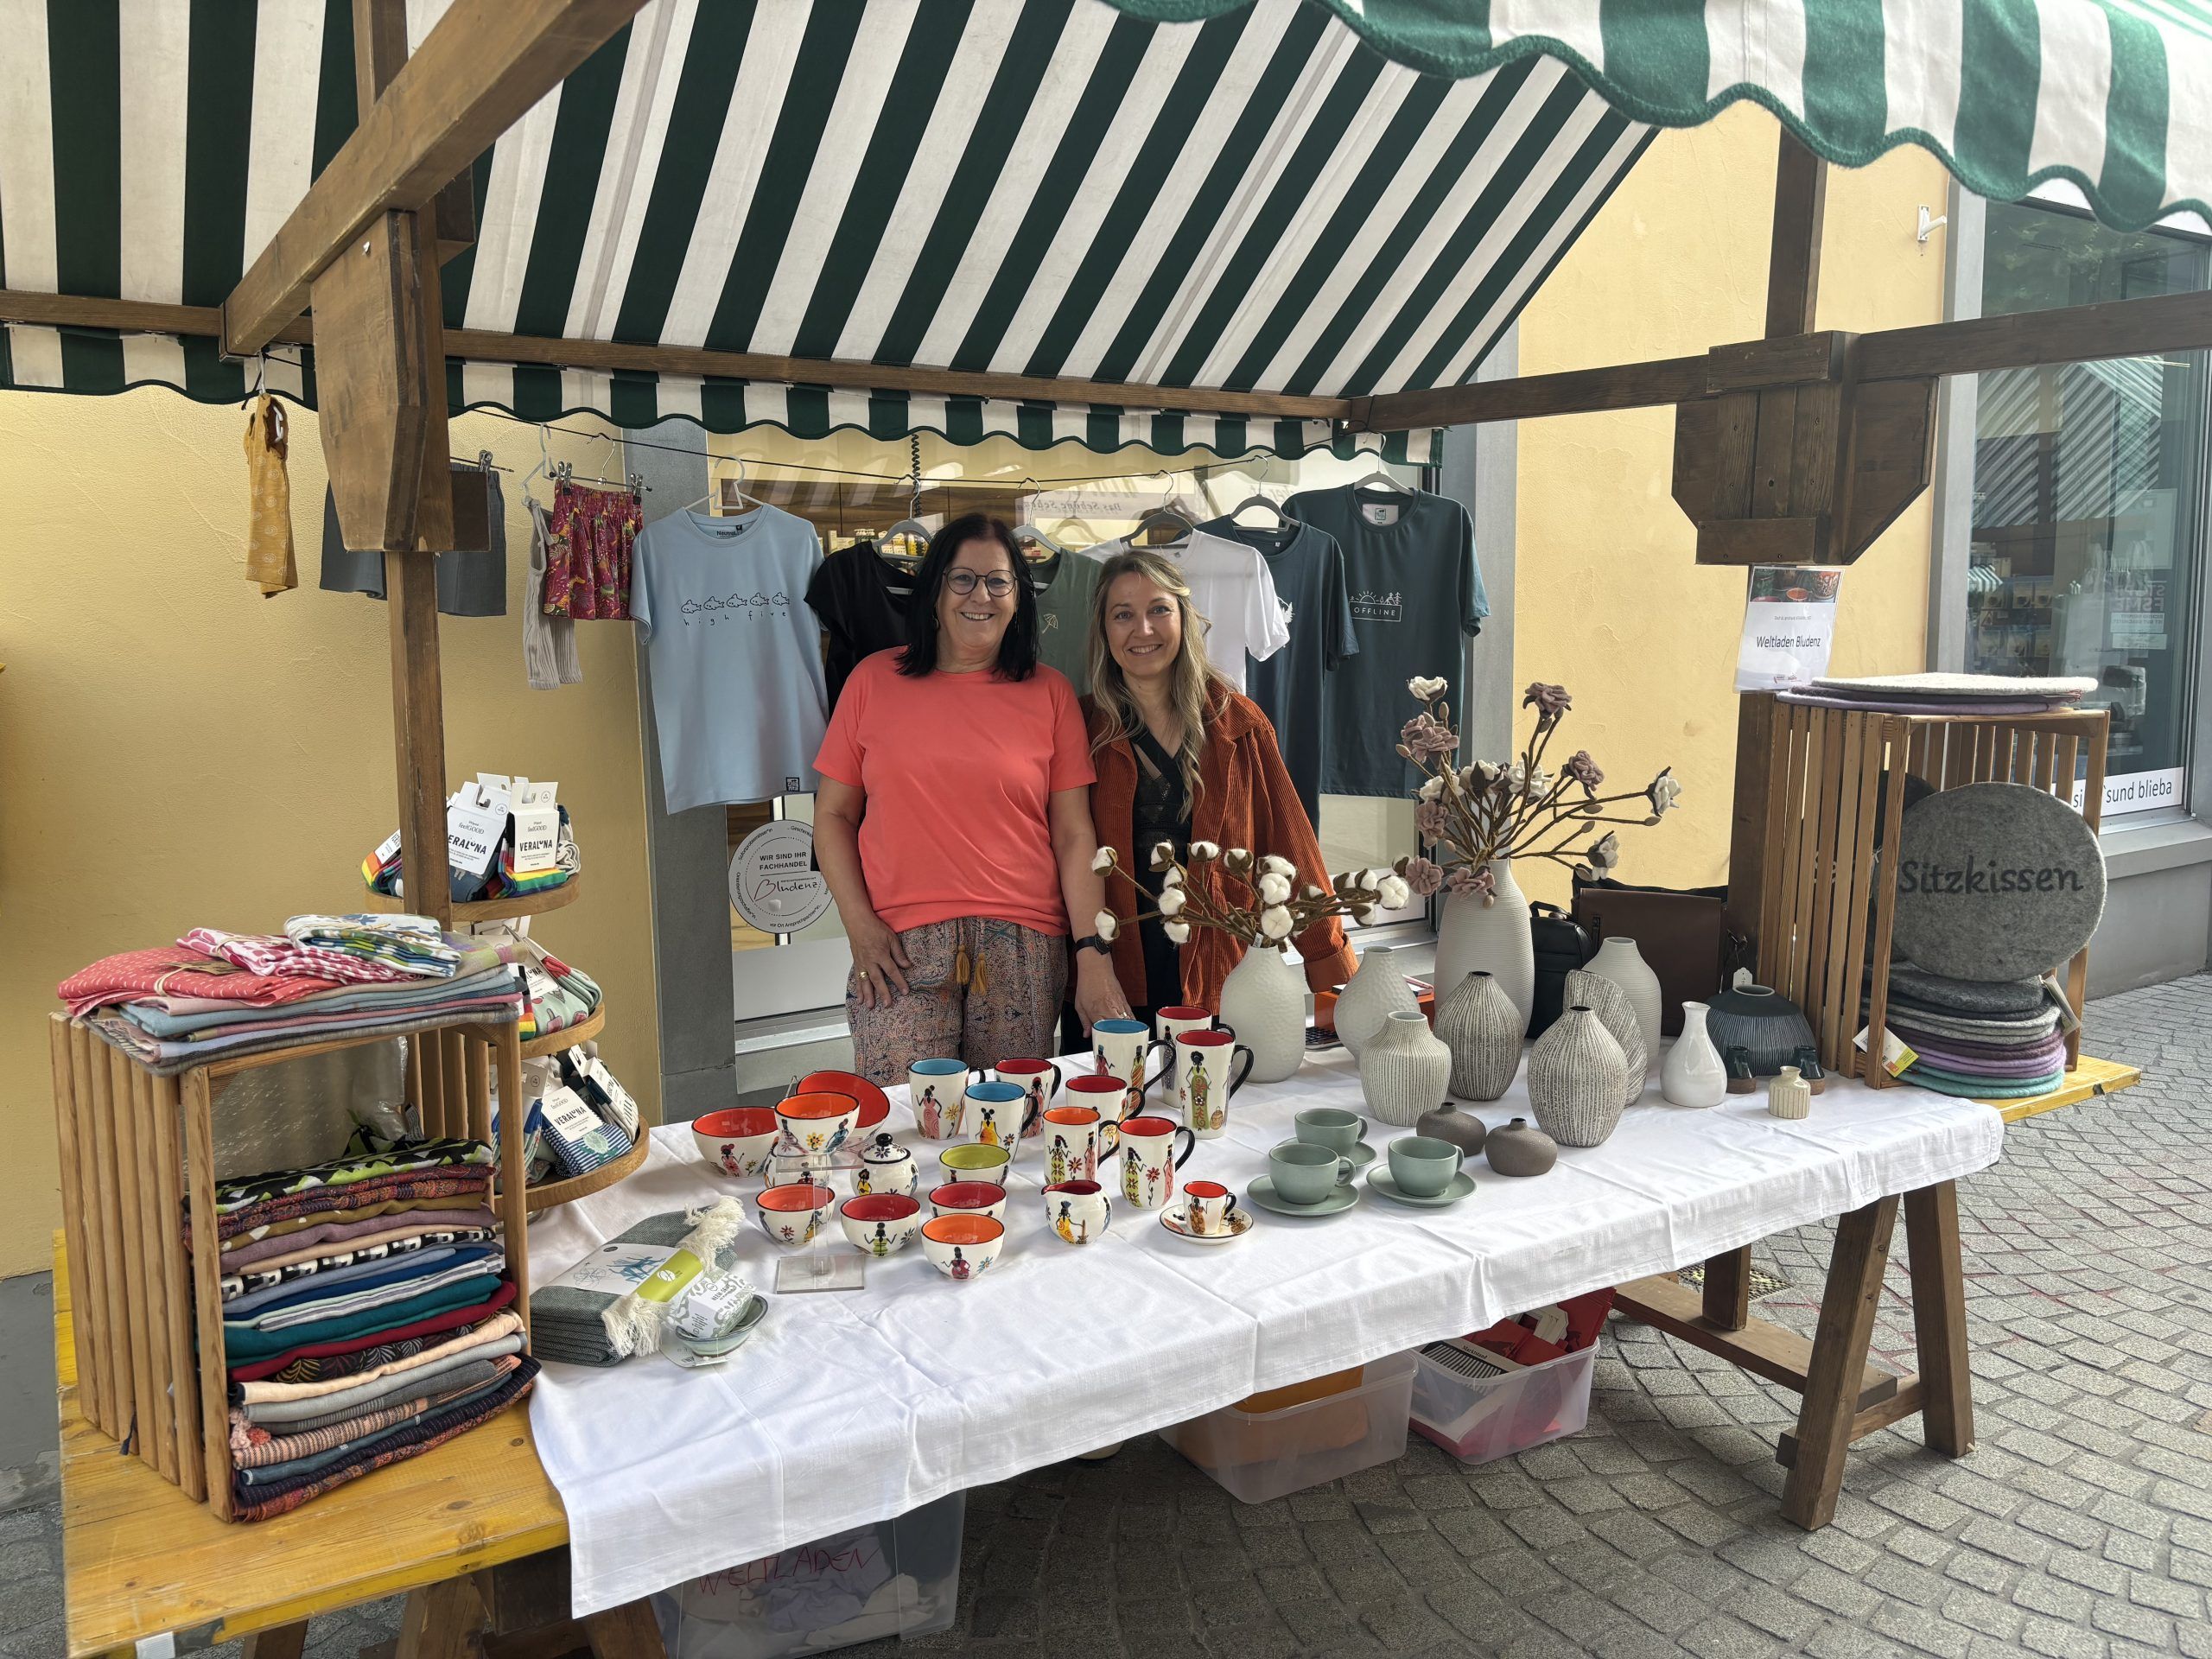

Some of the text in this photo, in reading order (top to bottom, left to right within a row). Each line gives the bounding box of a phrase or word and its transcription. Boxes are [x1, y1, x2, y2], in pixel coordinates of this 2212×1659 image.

[683, 610, 786, 626] high five
[1354, 607, 1395, 616] OFFLINE
[1757, 635, 1821, 648] Weltladen Bludenz
[2138, 779, 2172, 799] blieba
[448, 834, 487, 855] ERALUNA
[760, 861, 807, 870] FACHHANDEL
[1899, 855, 2084, 894] Sitzkissen
[698, 1546, 880, 1596] WELTLADEN
